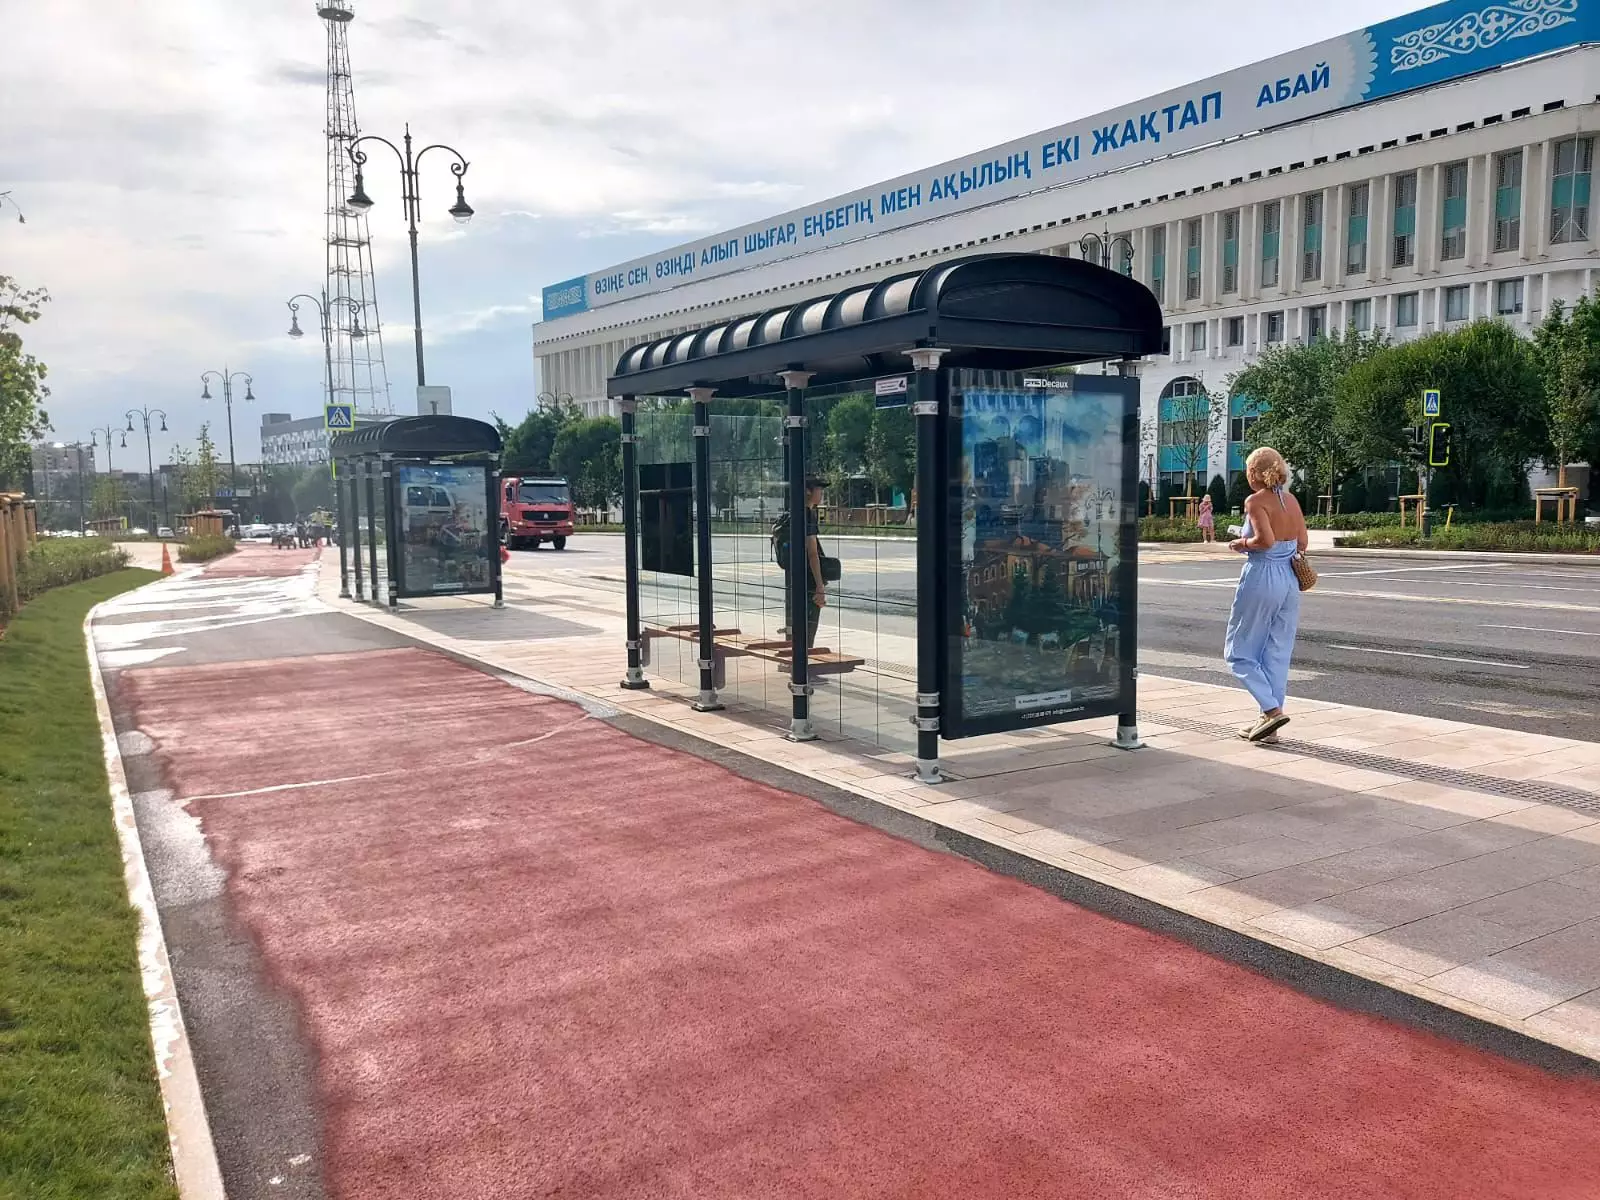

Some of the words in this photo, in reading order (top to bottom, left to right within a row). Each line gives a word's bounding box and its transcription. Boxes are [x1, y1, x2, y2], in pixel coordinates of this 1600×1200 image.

[628, 266, 651, 284] СЕН,
[656, 252, 695, 278] ӨЗІҢДІ
[701, 239, 738, 266] АЛЫП
[744, 223, 797, 254] ШЫҒАР,
[804, 199, 873, 237] ЕҢБЕГІҢ
[881, 184, 921, 215] МЕН
[929, 151, 1031, 201] АҚЫЛЫҢ
[1042, 135, 1080, 169] ЕКІ
[1092, 91, 1222, 155] ЖАҚТАП
[1256, 61, 1330, 108] АБАЙ
